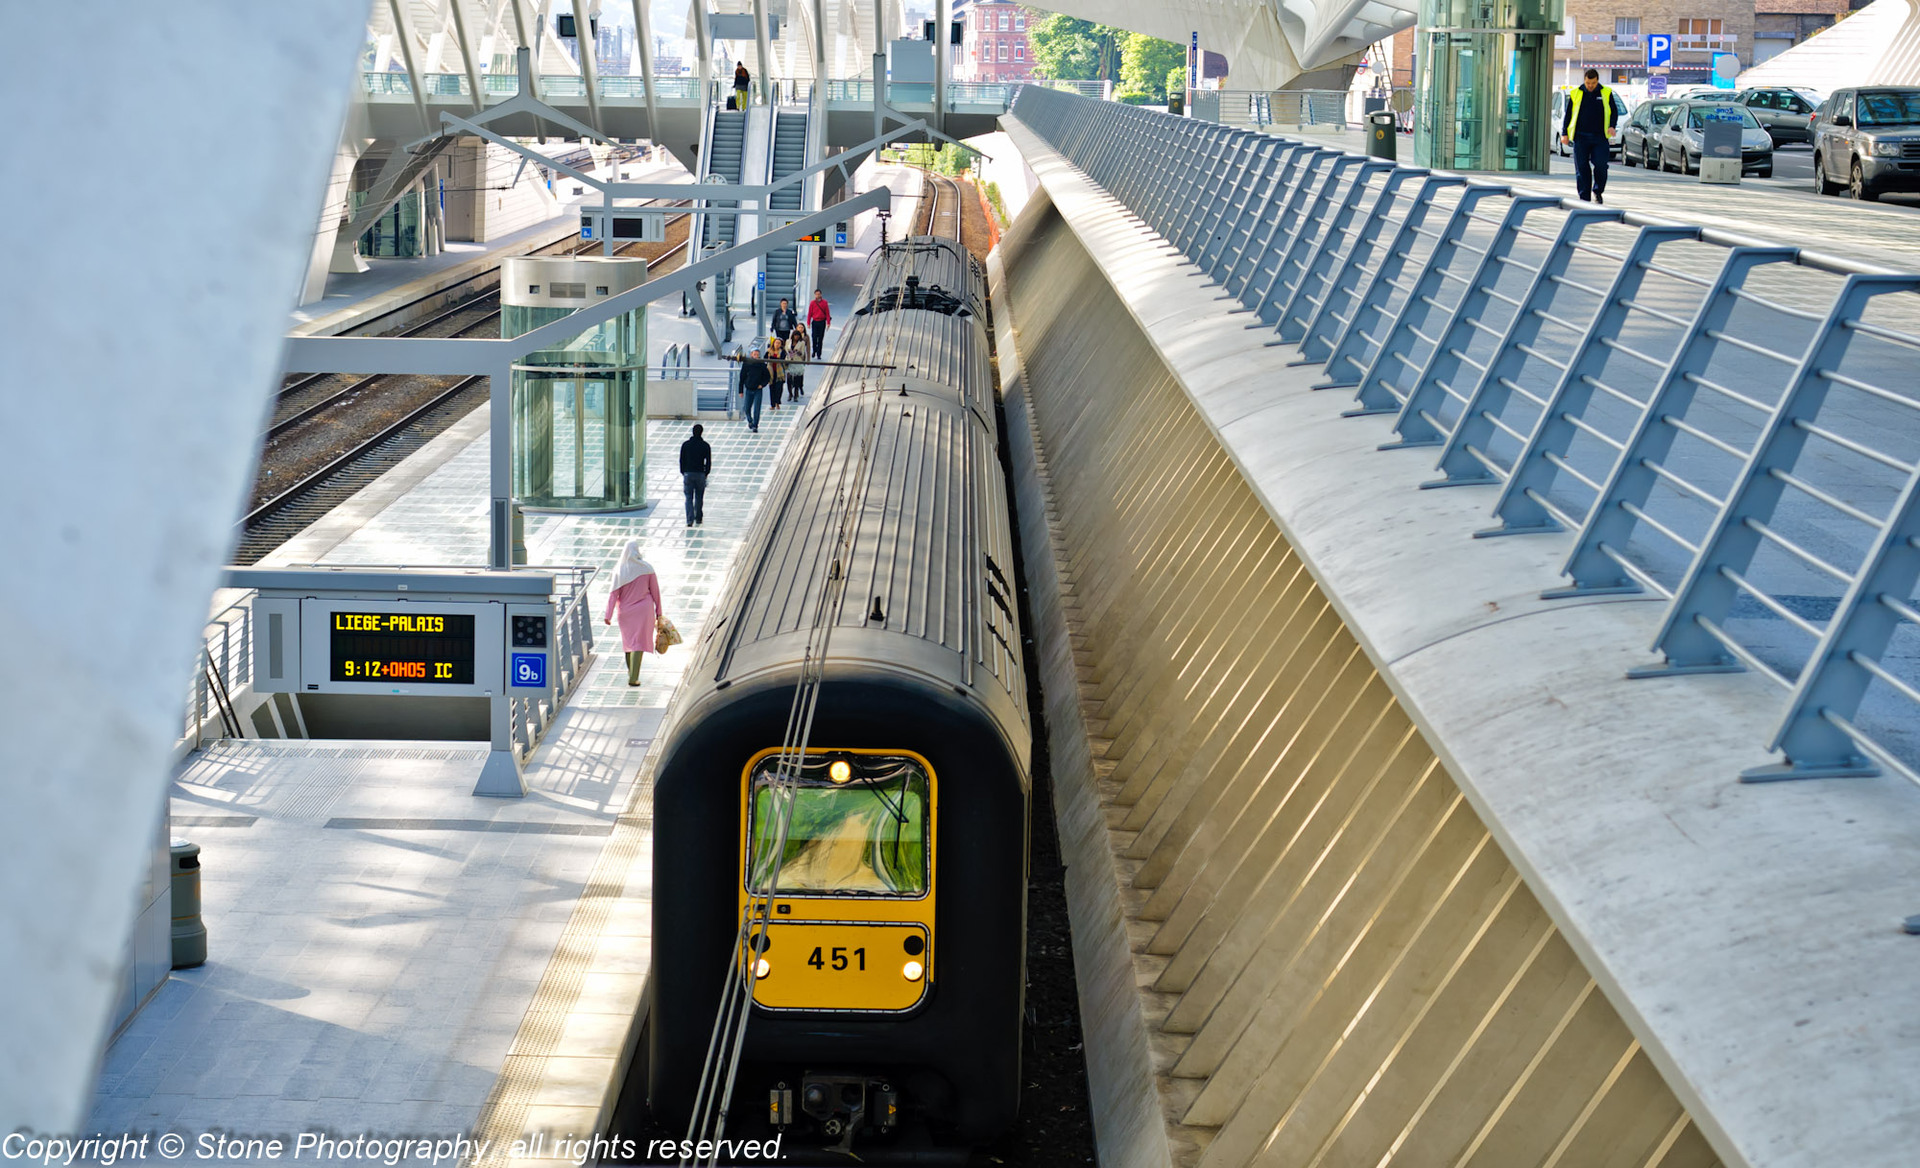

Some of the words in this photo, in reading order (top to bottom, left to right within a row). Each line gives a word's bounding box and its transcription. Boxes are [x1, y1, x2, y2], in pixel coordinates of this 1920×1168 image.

[1651, 36, 1669, 59] P
[336, 614, 444, 632] LIEGE-PALAIS
[434, 662, 453, 679] IC
[519, 664, 538, 681] 9b
[808, 946, 866, 971] 451
